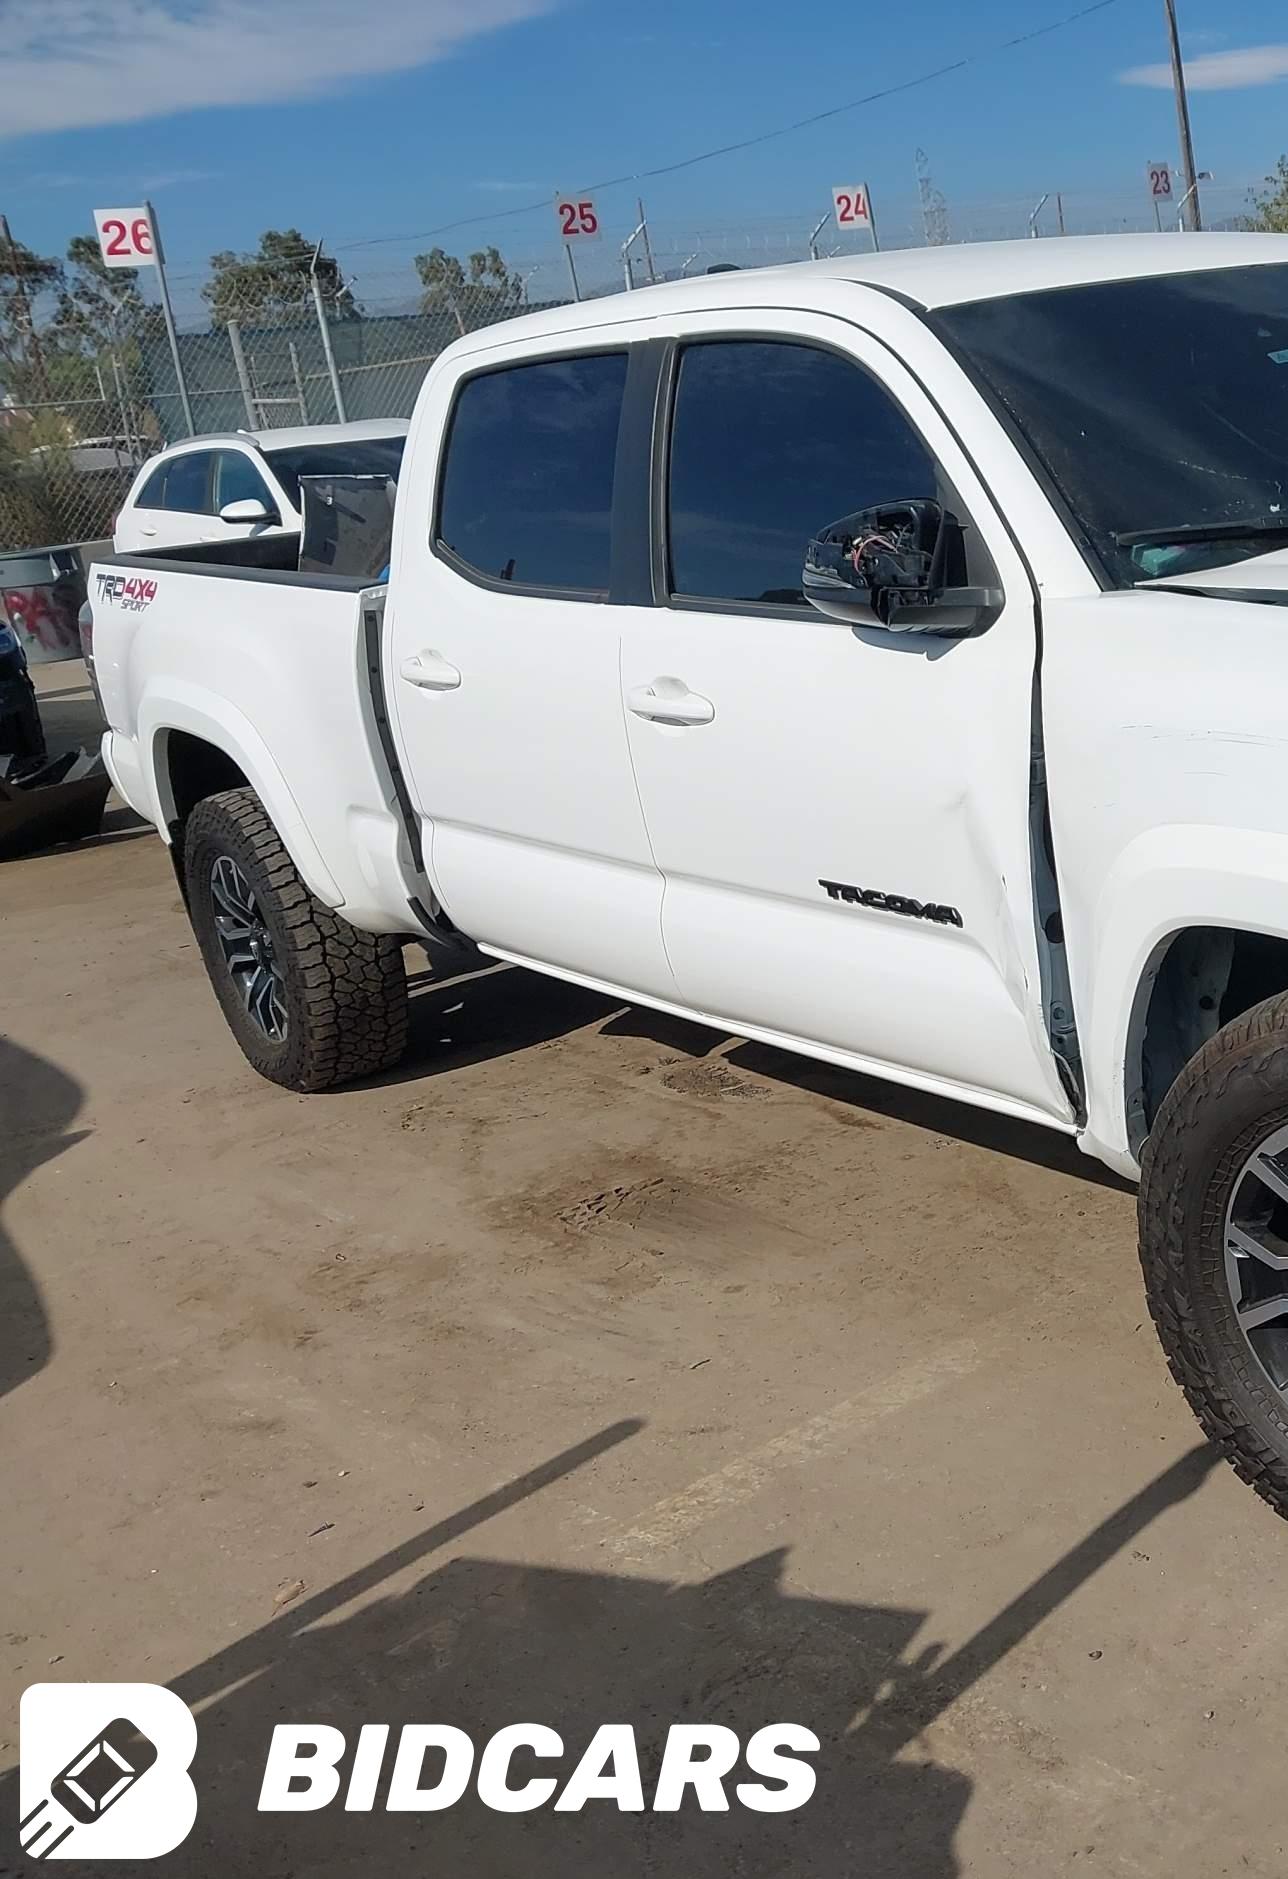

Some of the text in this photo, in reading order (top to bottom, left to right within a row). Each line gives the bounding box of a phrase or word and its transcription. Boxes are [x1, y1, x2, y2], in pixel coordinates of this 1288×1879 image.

[1151, 170, 1171, 195] 23
[559, 202, 598, 235] 25
[836, 193, 868, 222] 24
[102, 218, 153, 255] 26
[121, 599, 150, 612] SPORT
[818, 879, 963, 929] TACOMA
